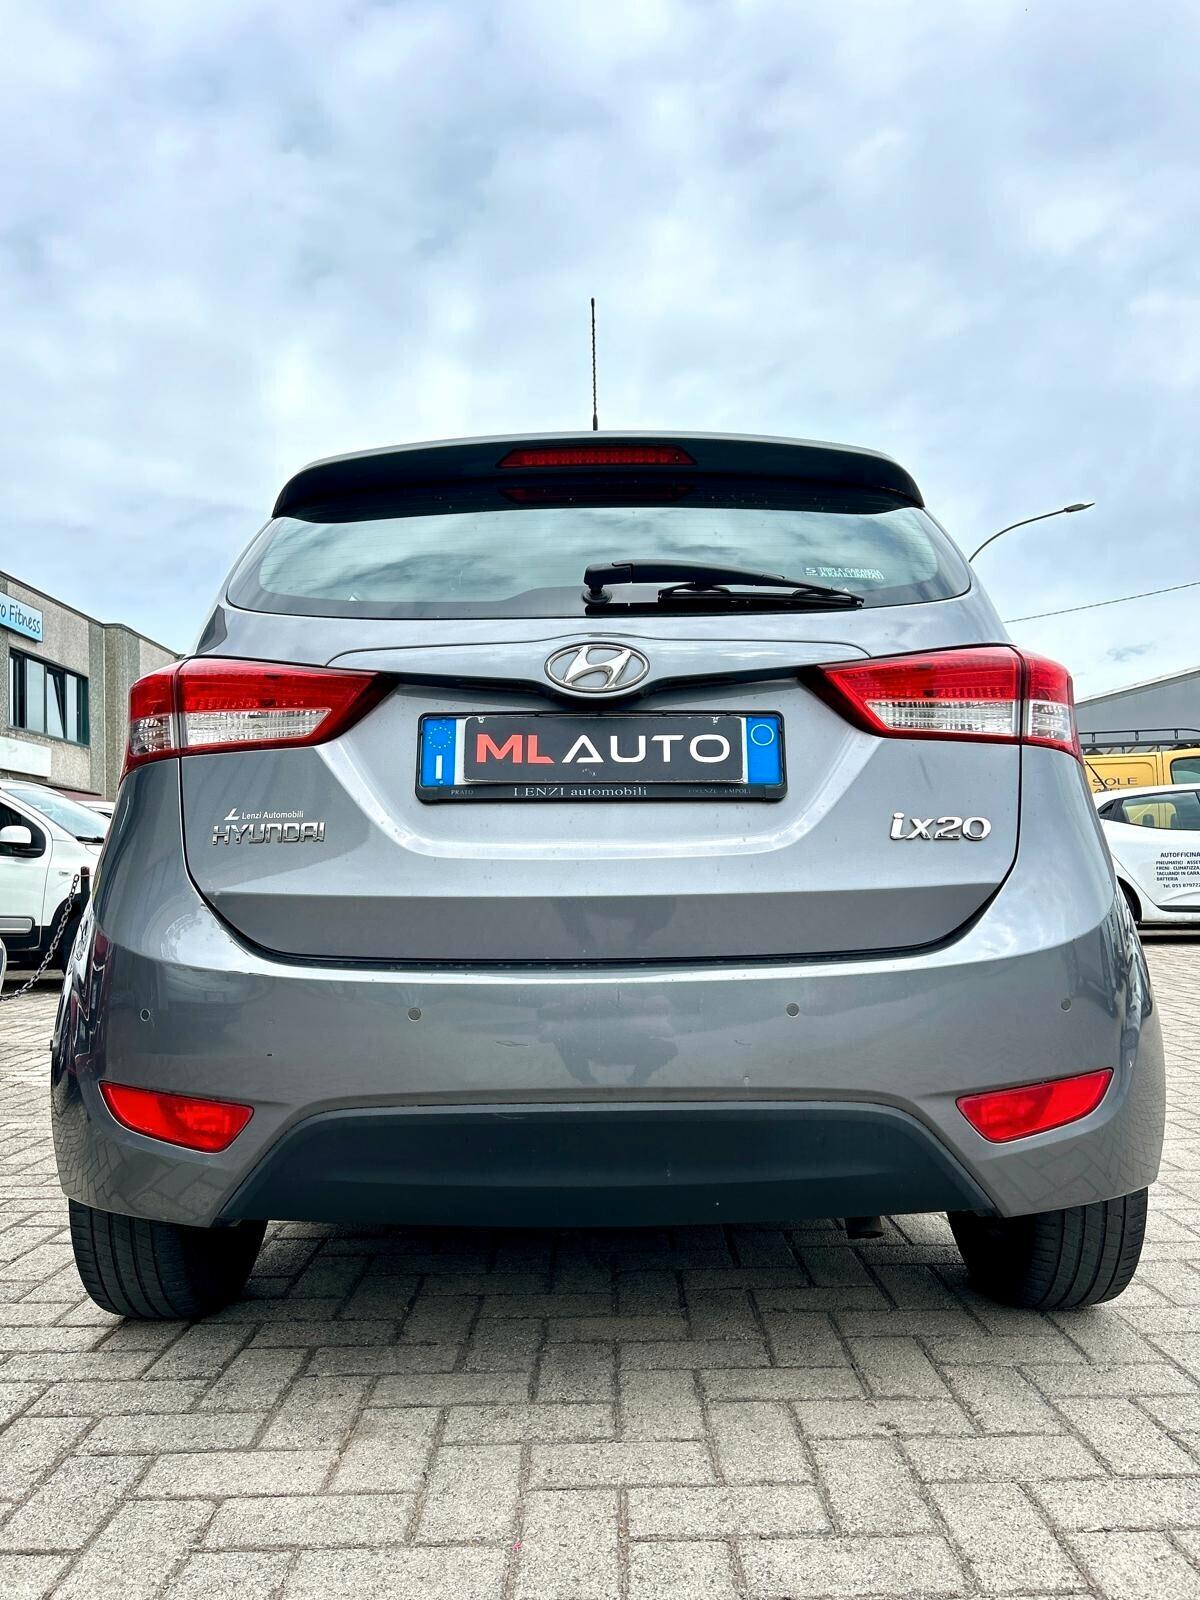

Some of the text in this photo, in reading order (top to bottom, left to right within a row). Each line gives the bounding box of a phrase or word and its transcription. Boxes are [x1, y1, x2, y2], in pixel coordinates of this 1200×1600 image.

[9, 604, 41, 634] Fitness
[476, 733, 731, 764] ML AUTO
[514, 786, 648, 797] LENZI automobili
[1092, 776, 1138, 786] SOLE
[241, 810, 304, 820] Lenzi Automobili
[890, 812, 992, 841] ix20
[212, 821, 326, 845] HYUNDAI
